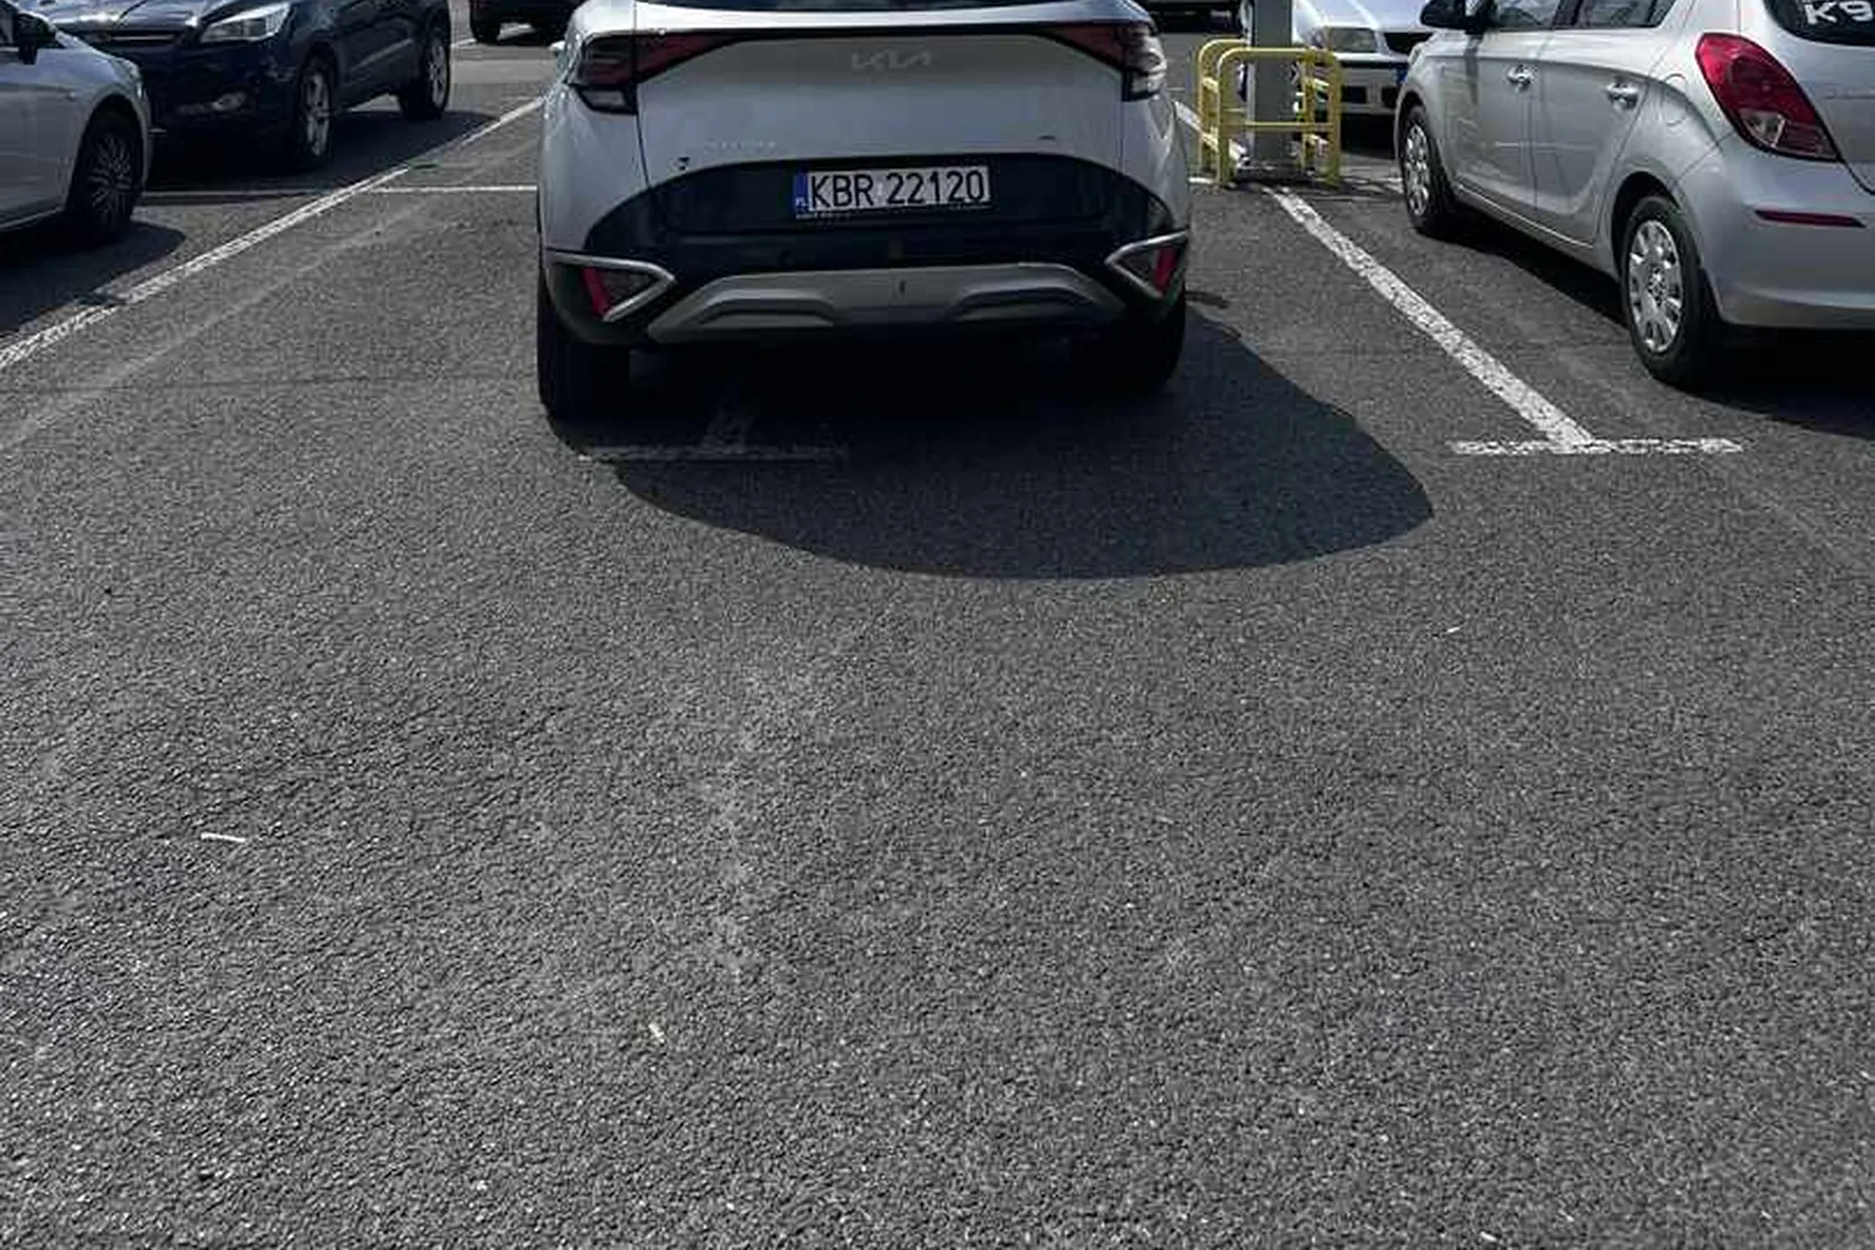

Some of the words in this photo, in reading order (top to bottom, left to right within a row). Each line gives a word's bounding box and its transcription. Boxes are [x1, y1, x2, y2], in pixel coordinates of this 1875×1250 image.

[1804, 0, 1874, 25] K9
[851, 47, 932, 70] KIA
[811, 174, 875, 208] KBR
[885, 170, 985, 205] 22120
